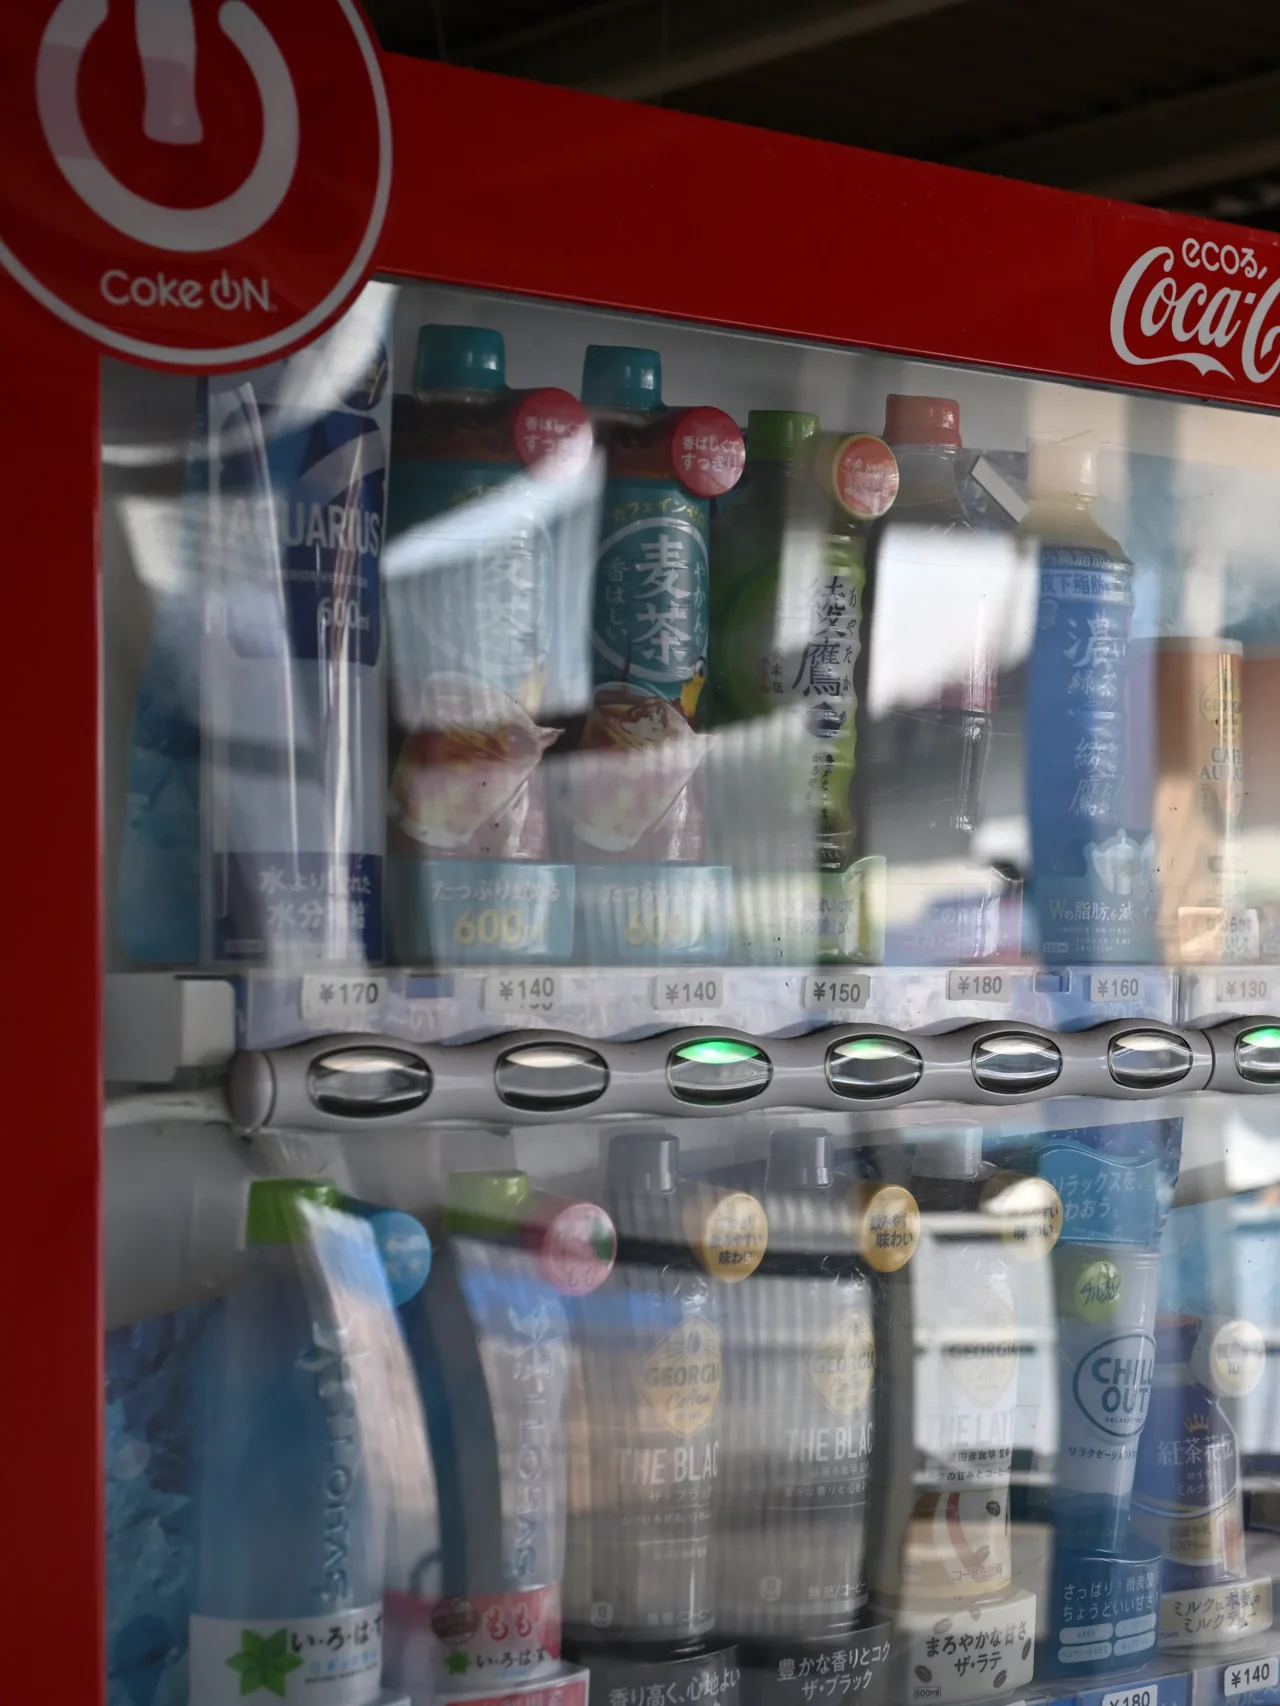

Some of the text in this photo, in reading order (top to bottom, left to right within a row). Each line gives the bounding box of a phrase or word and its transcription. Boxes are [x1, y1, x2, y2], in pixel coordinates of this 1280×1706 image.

[101, 269, 270, 312] Coke ON
[605, 557, 631, 642] 香ばしい
[631, 533, 693, 667] 麦茶
[319, 982, 379, 1004] ¥170
[499, 977, 555, 1001] ¥140
[664, 980, 717, 1004] ¥140
[812, 981, 861, 1002] ¥150
[958, 975, 1003, 995] ¥180
[1097, 978, 1139, 998] ¥160
[1226, 980, 1267, 999] ¥130
[876, 1230, 913, 1249] 味わい
[718, 1249, 753, 1266] 味わい
[1091, 1357, 1153, 1385] CHILL
[1101, 1386, 1148, 1414] OUT
[785, 1424, 874, 1463] THE BLAC
[616, 1449, 668, 1485] THE
[1174, 1585, 1262, 1617] ミルクに本気の
[486, 1604, 532, 1641] もも
[1183, 1611, 1257, 1634] ミルクティー
[926, 1621, 1027, 1658] まろやかな甘さ
[777, 1641, 891, 1683] 豊かな香りとコク
[954, 1651, 1002, 1677] ザ・ラテ
[608, 1668, 740, 1706] 香り高く、心地よい
[801, 1669, 873, 1700] ザ・ブラック
[1231, 1663, 1271, 1689] ¥140
[915, 1688, 940, 1698] 500ml
